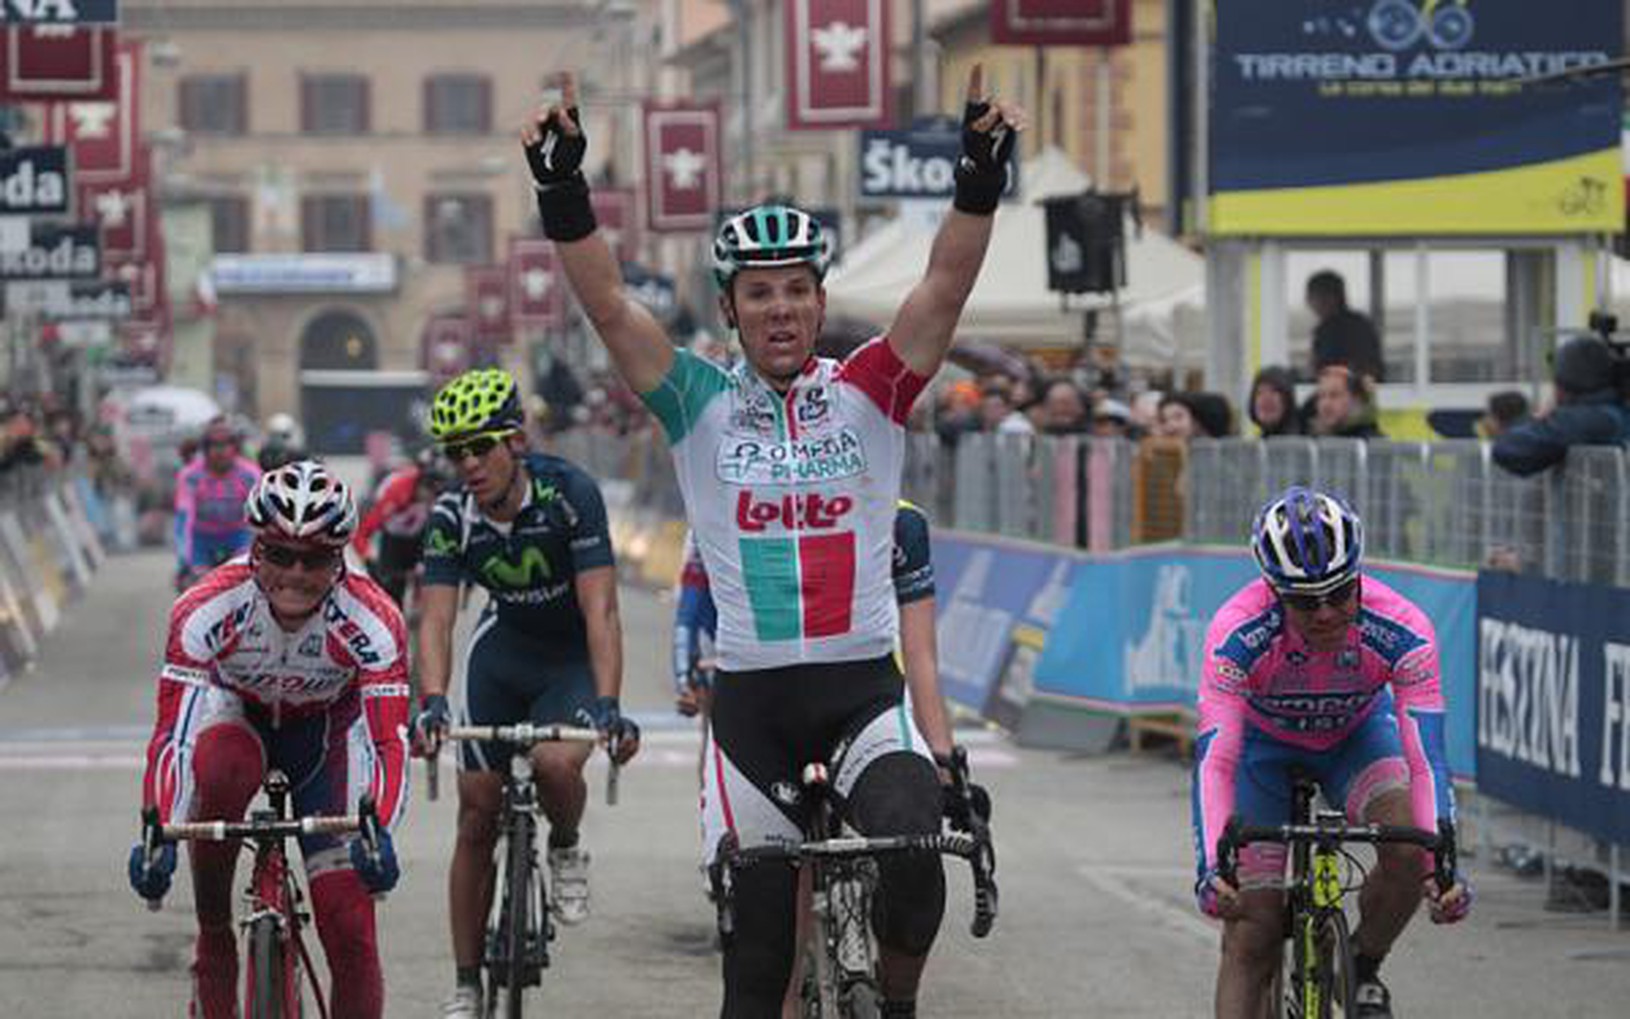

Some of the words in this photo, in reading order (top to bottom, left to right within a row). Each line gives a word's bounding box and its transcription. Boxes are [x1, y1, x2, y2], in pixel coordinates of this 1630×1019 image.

[1235, 52, 1396, 78] TIRRENO
[1408, 51, 1609, 78] ADRIATICO
[1479, 616, 1581, 778] FESTINA
